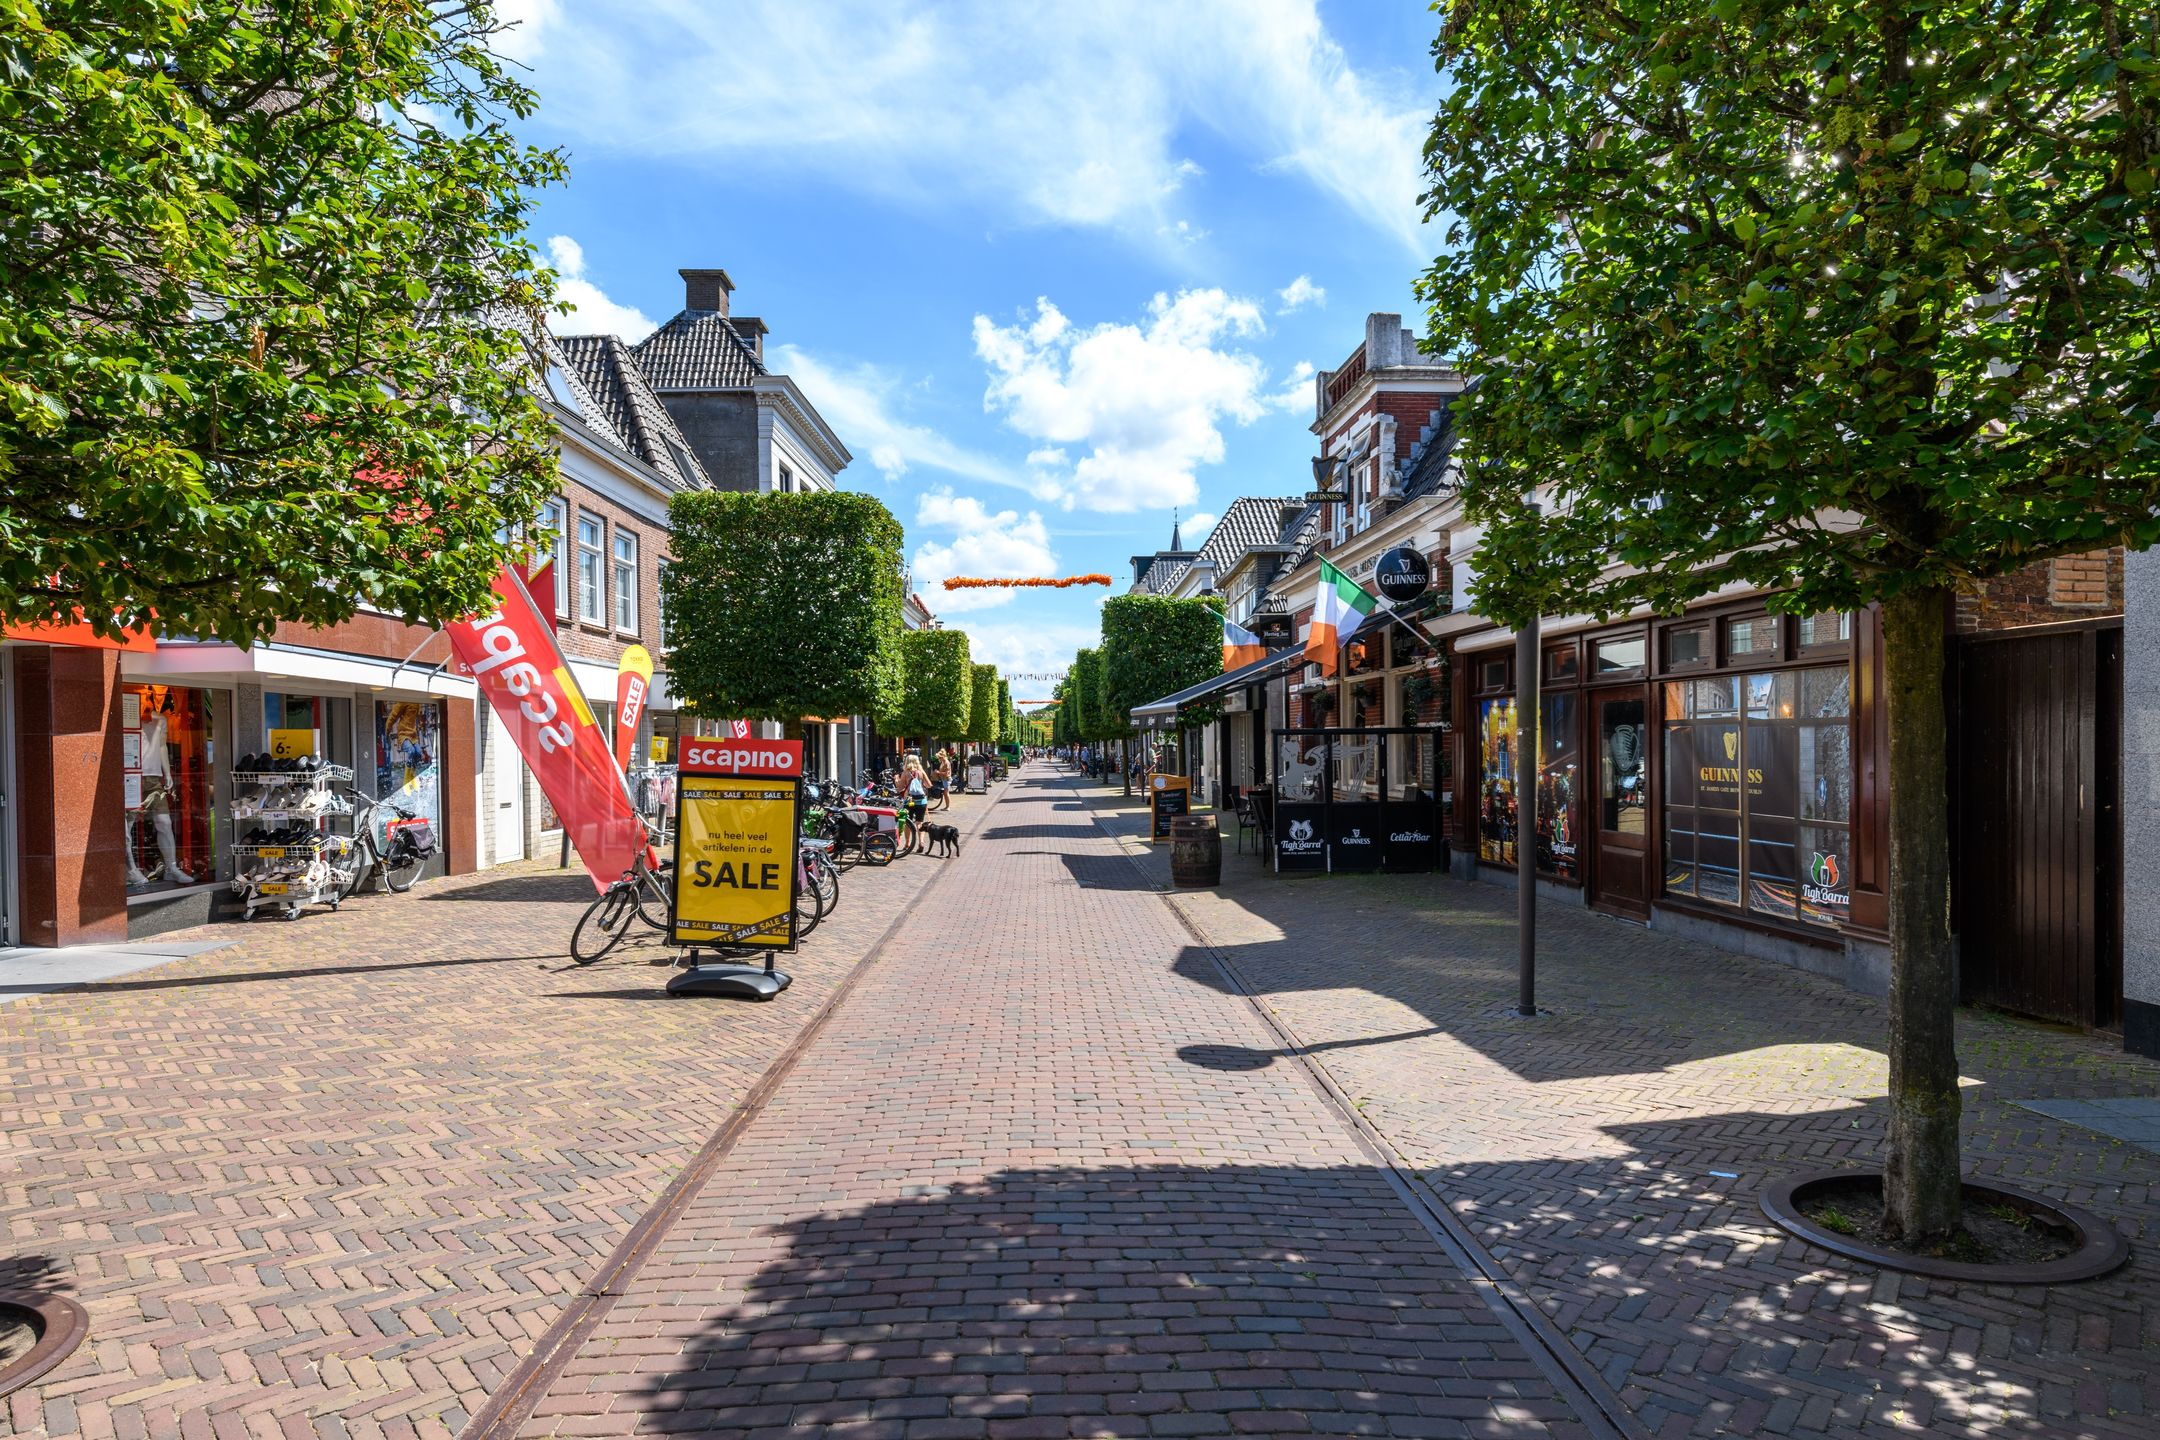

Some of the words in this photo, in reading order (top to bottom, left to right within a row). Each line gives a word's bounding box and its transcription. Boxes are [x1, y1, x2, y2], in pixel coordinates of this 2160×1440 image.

[1381, 573, 1426, 585] GUINNESS
[624, 680, 642, 724] SALE
[687, 748, 793, 774] scapino
[1700, 767, 1763, 784] GUINNSS
[708, 831, 721, 840] nu
[723, 831, 745, 841] heel
[747, 832, 768, 841] veel
[1342, 837, 1371, 845] GUINNESS
[702, 843, 745, 853] artikelen
[748, 844, 757, 853] in
[759, 845, 773, 854] de
[1281, 840, 1298, 851] Tigh
[1298, 840, 1321, 850] Barra
[692, 860, 780, 891] SALE
[1802, 884, 1821, 903] Tigh
[1821, 888, 1849, 904] Barra
[712, 923, 729, 931] SALE
[736, 926, 758, 939] SALE
[759, 918, 781, 931] SALE
